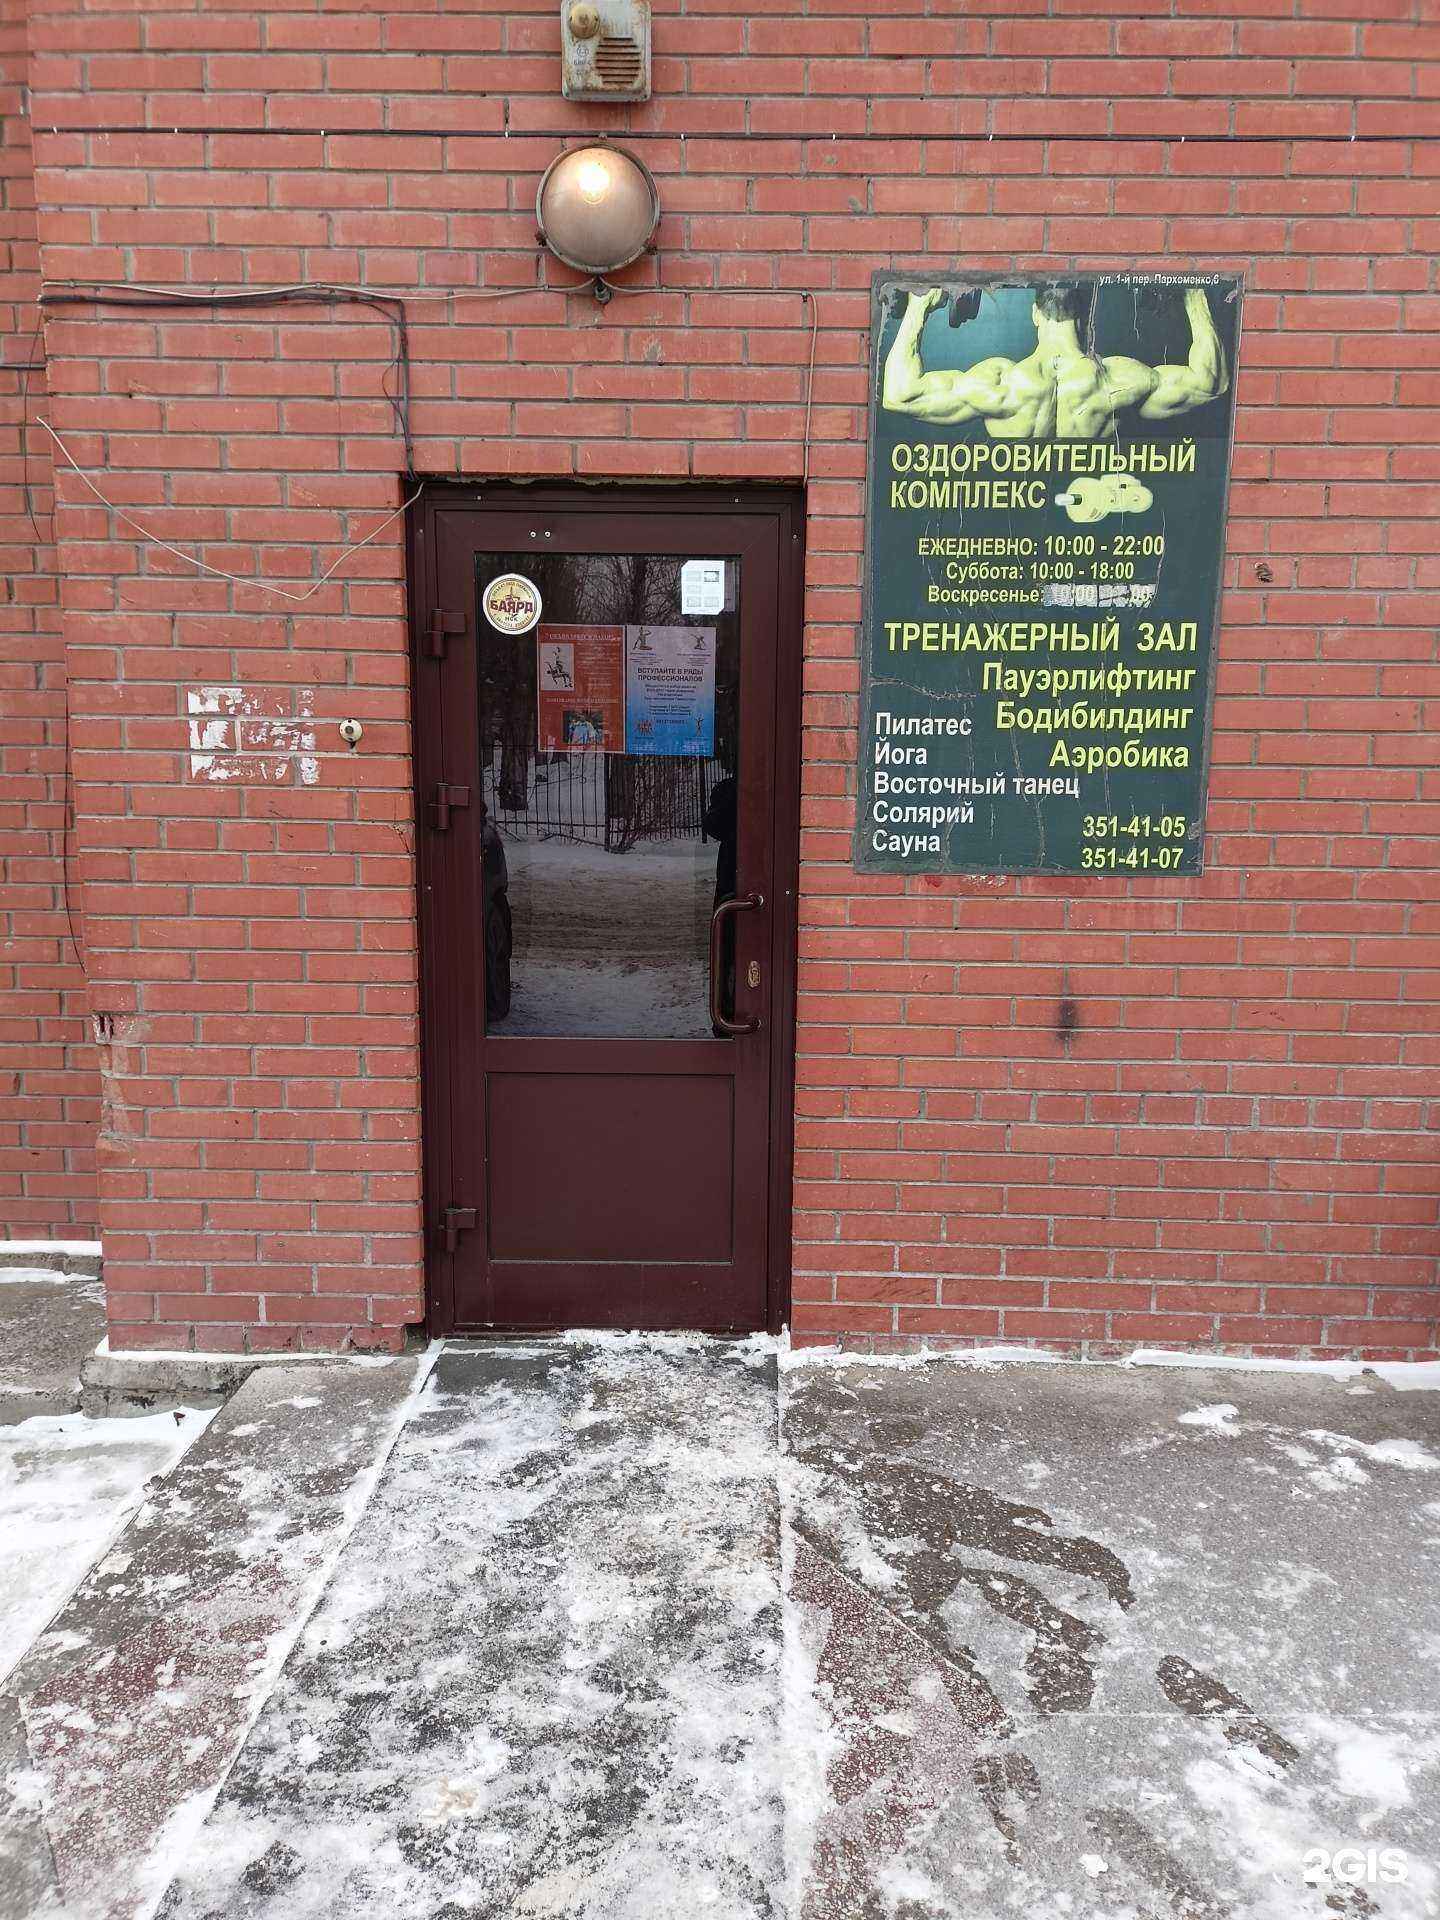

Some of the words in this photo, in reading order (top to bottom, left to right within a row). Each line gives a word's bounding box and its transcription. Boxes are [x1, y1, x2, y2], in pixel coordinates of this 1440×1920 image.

[1099, 275, 1113, 286] ул.
[1132, 275, 1152, 286] пер.
[891, 438, 1196, 477] ОЗДОРОВИТЕЛЬНЫЙ
[891, 480, 1046, 509] КОМПЛЕКС
[918, 537, 1038, 558] ЕЖЕДНЕВНО:
[1044, 535, 1095, 556] 10:00
[1113, 535, 1165, 556] 22:00
[946, 562, 1024, 583] Суббота:
[1029, 562, 1074, 579] 10:00
[1090, 562, 1135, 579] 18:00
[490, 600, 533, 614] БАЯРД
[928, 584, 1044, 606] Воскресенье:
[884, 616, 1120, 651] ТРЕНАЖЕРНЫЙ
[1137, 622, 1198, 651] ЗАЛ
[982, 662, 1197, 697] Пауэрлифтинг
[875, 712, 973, 735] Пилатес
[996, 701, 1194, 733] Бодибилдинг
[874, 737, 928, 766] Йога
[1049, 739, 1189, 773] Аэробика
[873, 771, 1006, 796] Восточный
[1012, 776, 1080, 798] танец
[872, 800, 974, 826] Солярий
[1082, 815, 1187, 839] 351-41-05
[872, 829, 941, 857] Сауна
[1081, 847, 1185, 870] 351-41-07
